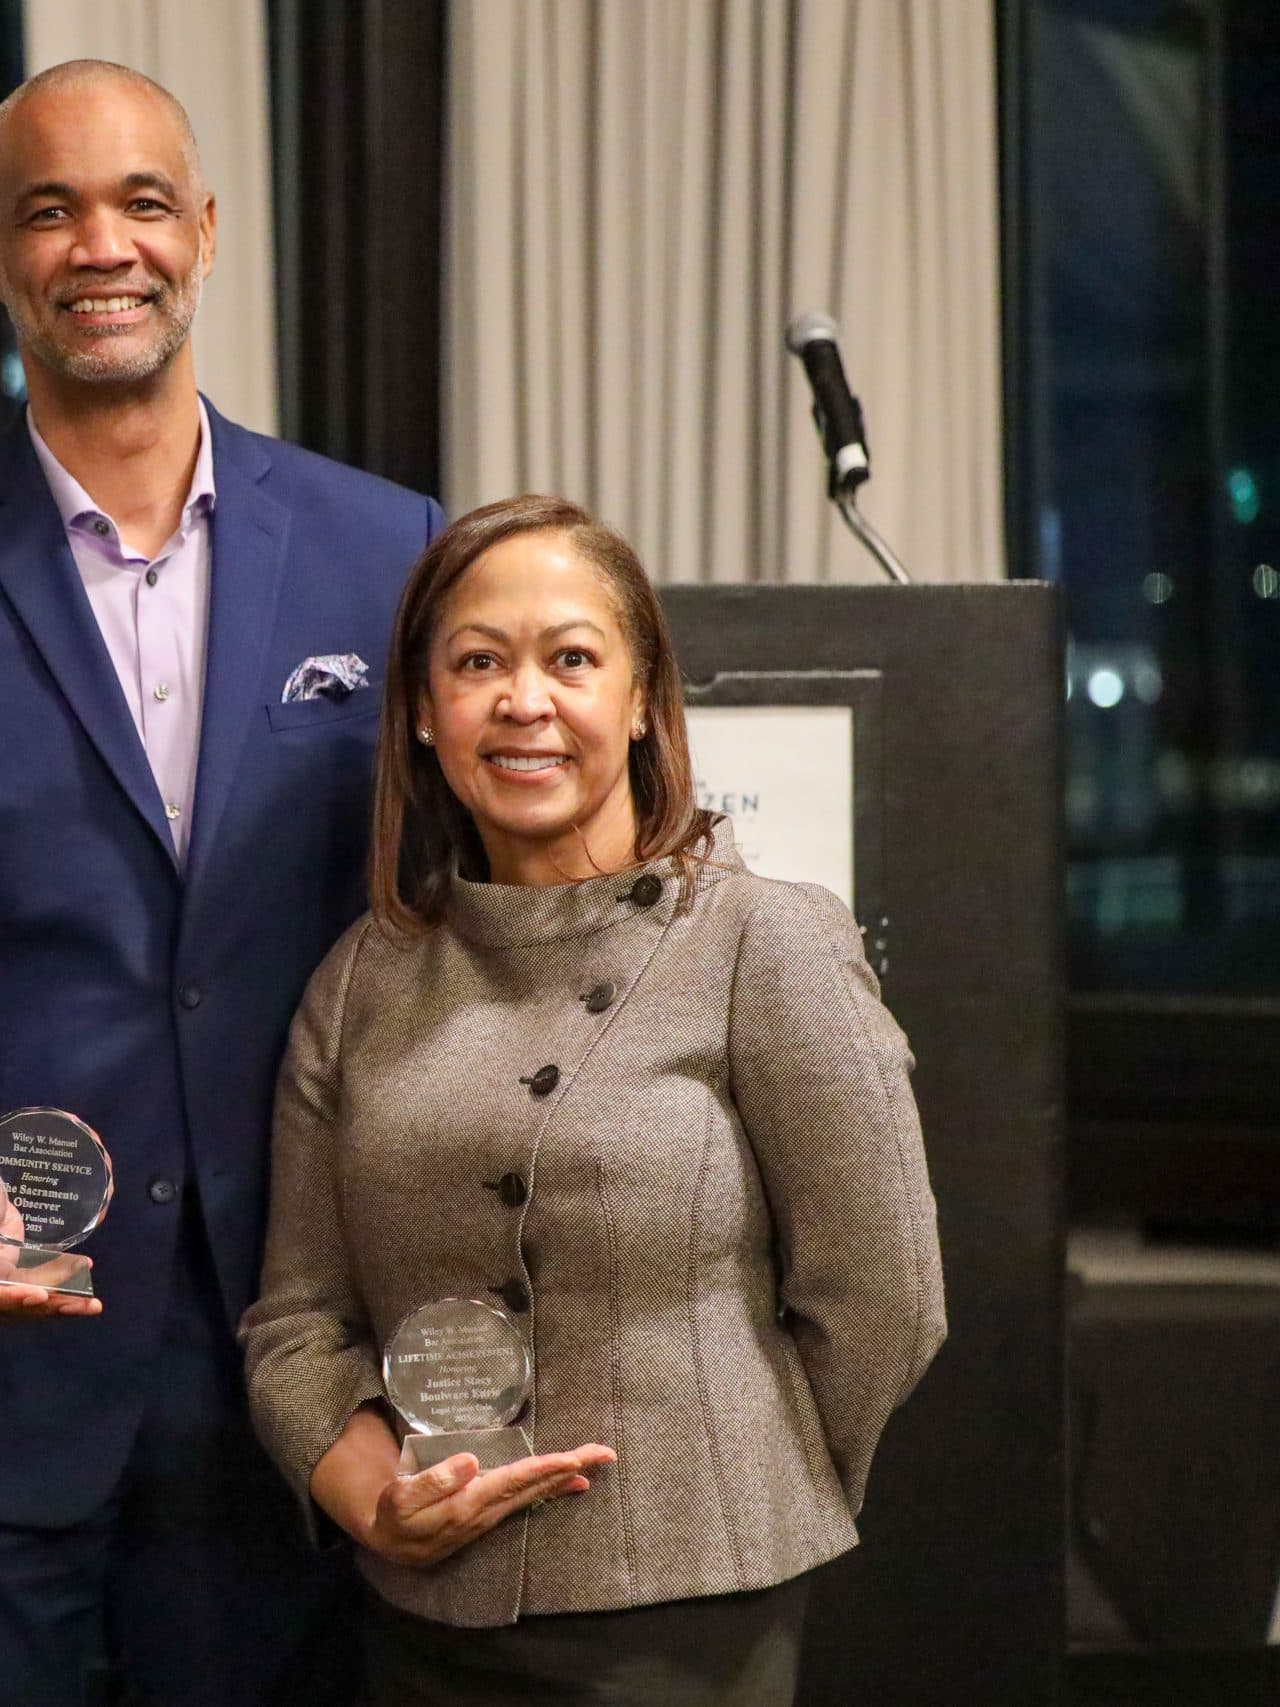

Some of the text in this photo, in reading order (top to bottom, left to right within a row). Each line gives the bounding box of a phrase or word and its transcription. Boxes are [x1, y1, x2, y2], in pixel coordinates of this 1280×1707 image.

[703, 792, 759, 813] ZEN
[12, 1132, 78, 1148] Wiley W. Manuel
[13, 1143, 73, 1158] Bar Association
[52, 1162, 93, 1175] SERVICE
[21, 1172, 59, 1186] Honoring
[20, 1184, 79, 1201] Sacramento
[13, 1197, 61, 1212] Observer
[25, 1213, 48, 1223] Fusion
[49, 1216, 65, 1226] Gala
[25, 1224, 42, 1232] 2025
[421, 1326, 443, 1337] Wiley
[424, 1339, 439, 1347] Bar
[398, 1352, 442, 1363] LIFETIME
[426, 1377, 461, 1388] Justice
[420, 1390, 470, 1402] Boulware
